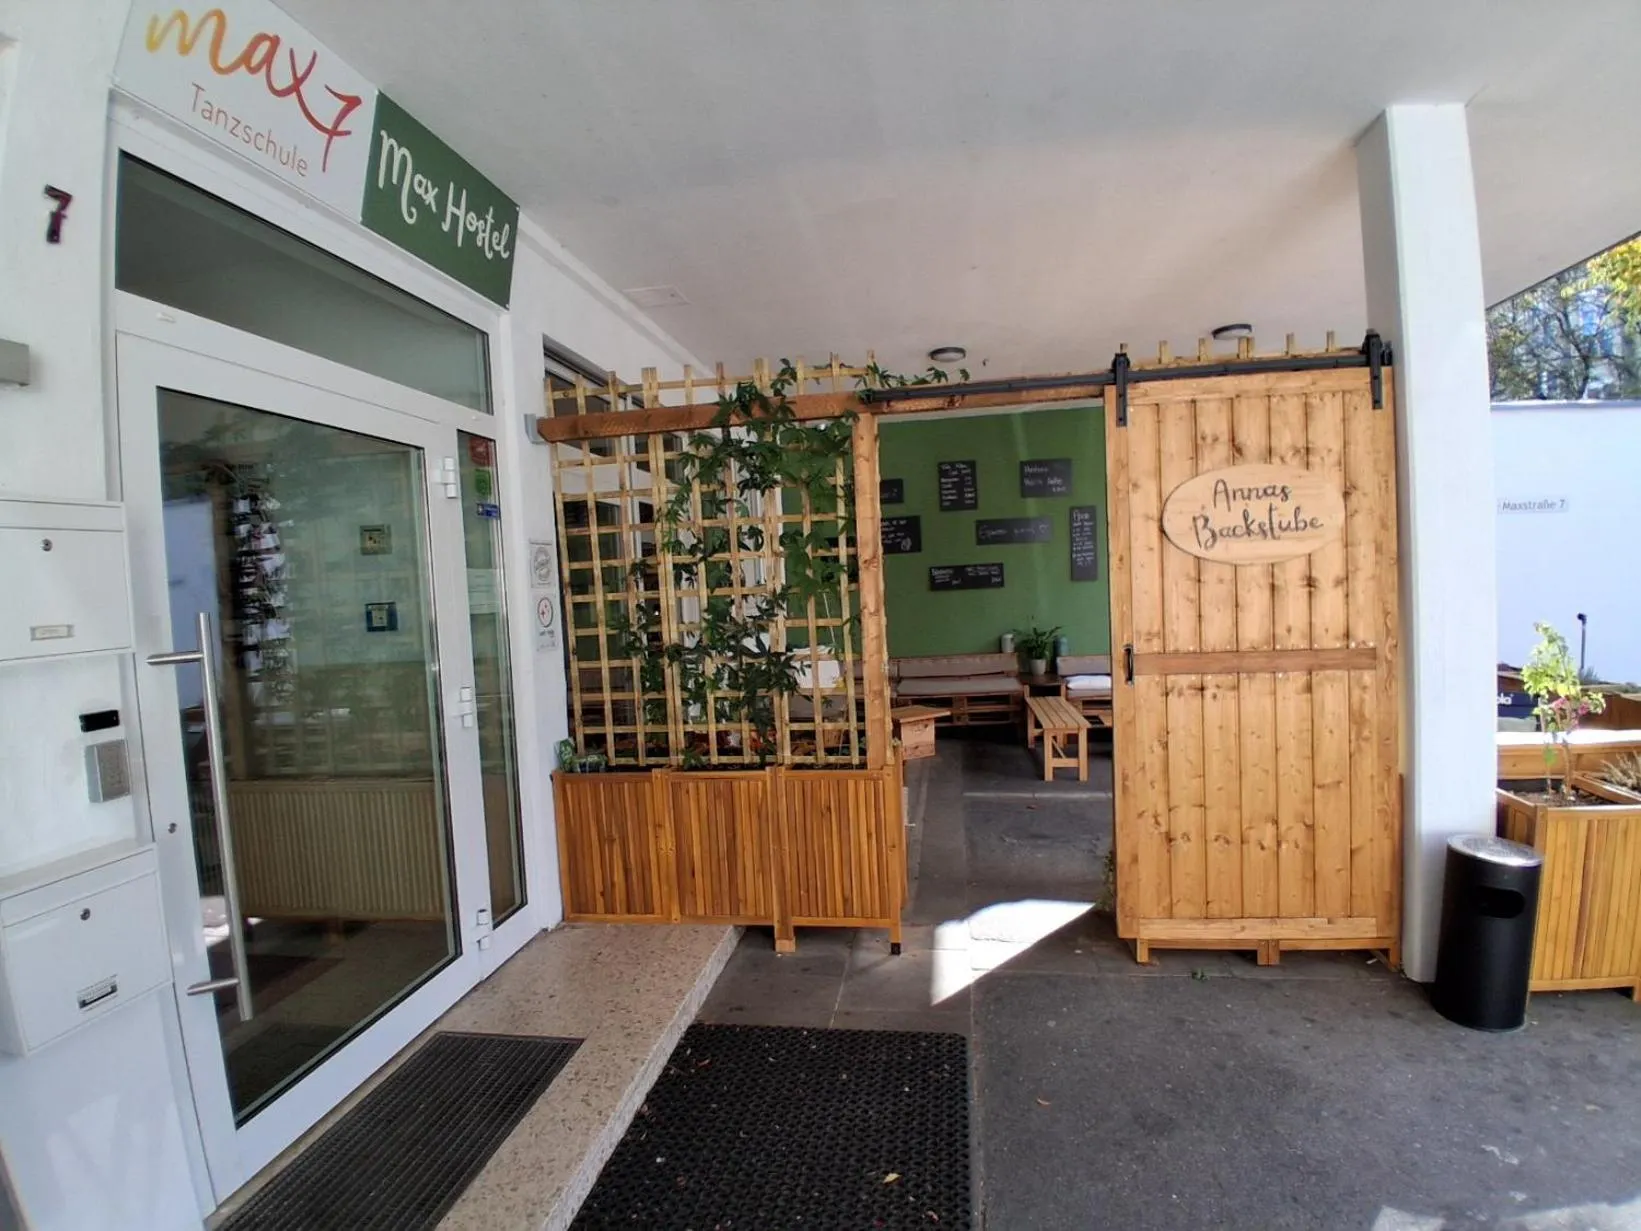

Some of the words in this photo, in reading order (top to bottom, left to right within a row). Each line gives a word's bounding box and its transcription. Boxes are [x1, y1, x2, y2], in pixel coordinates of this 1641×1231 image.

[190, 82, 309, 178] Tanzschule
[44, 184, 73, 245] 7
[378, 129, 438, 225] Max
[442, 182, 511, 260] Hostel
[1213, 478, 1292, 513] Annas
[1502, 498, 1557, 511] Maxstraße
[1559, 498, 1566, 509] 7
[1192, 502, 1324, 550] Backstube
